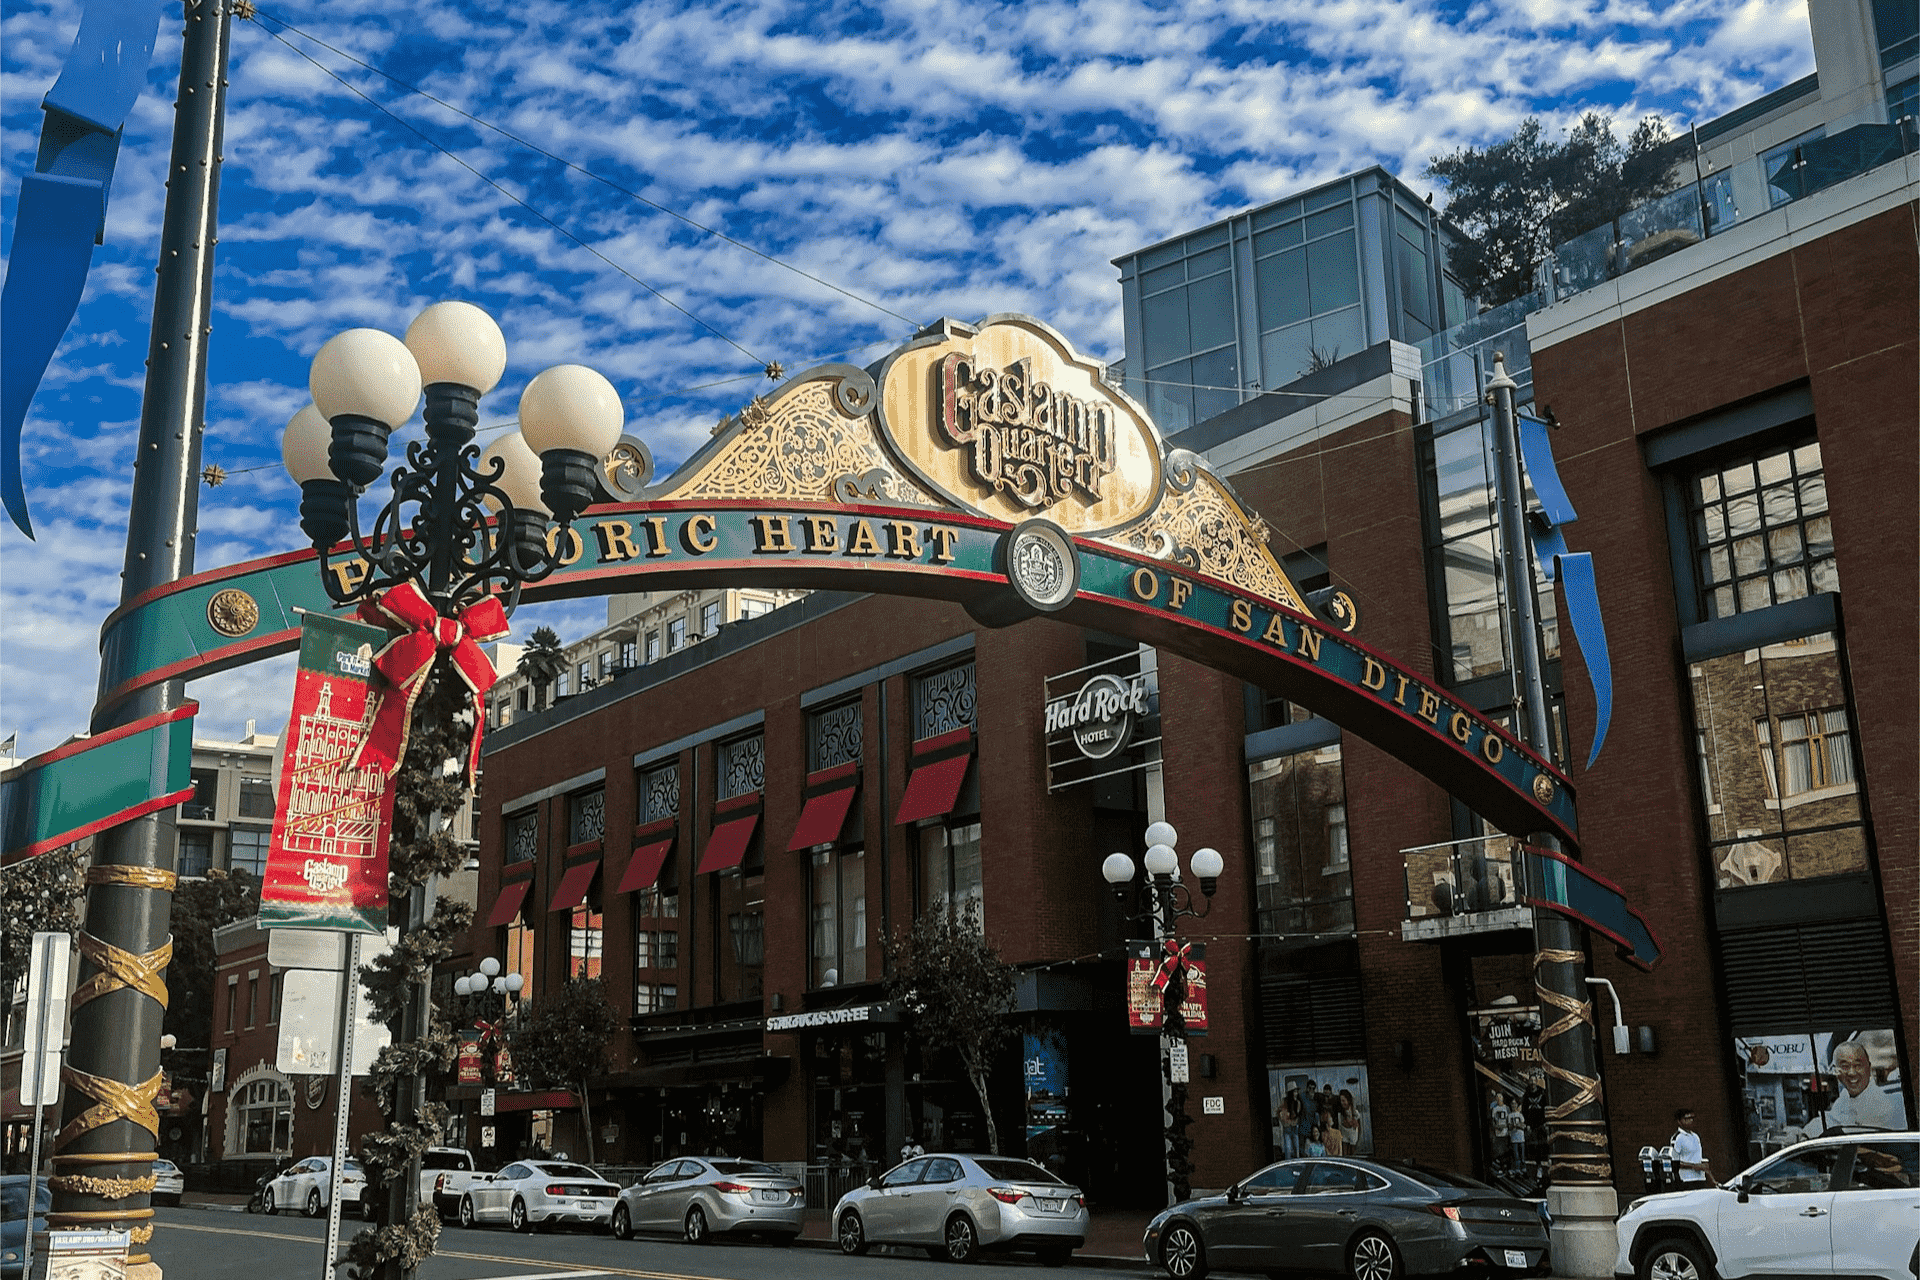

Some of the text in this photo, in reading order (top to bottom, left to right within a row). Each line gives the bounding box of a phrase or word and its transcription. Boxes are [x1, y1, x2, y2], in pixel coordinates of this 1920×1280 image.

[942, 351, 1117, 474] Gaslamp
[975, 422, 1104, 508] Quarter
[755, 514, 960, 563] HEART
[1131, 567, 1193, 610] OF
[1232, 596, 1325, 662] SAN
[1361, 655, 1505, 765] DIEGO
[1044, 679, 1144, 734] Hard Rock
[1080, 729, 1110, 745] HOTEL
[303, 857, 349, 882] Gaslamp
[766, 1006, 869, 1031] STARBUCKS COFFEE
[1489, 1023, 1512, 1039] JOIN
[1491, 1038, 1507, 1048] HARD
[1523, 1036, 1530, 1047] X
[1765, 1043, 1805, 1055] NOBU
[1494, 1047, 1519, 1060] MESSI
[1205, 1099, 1221, 1108] FDC
